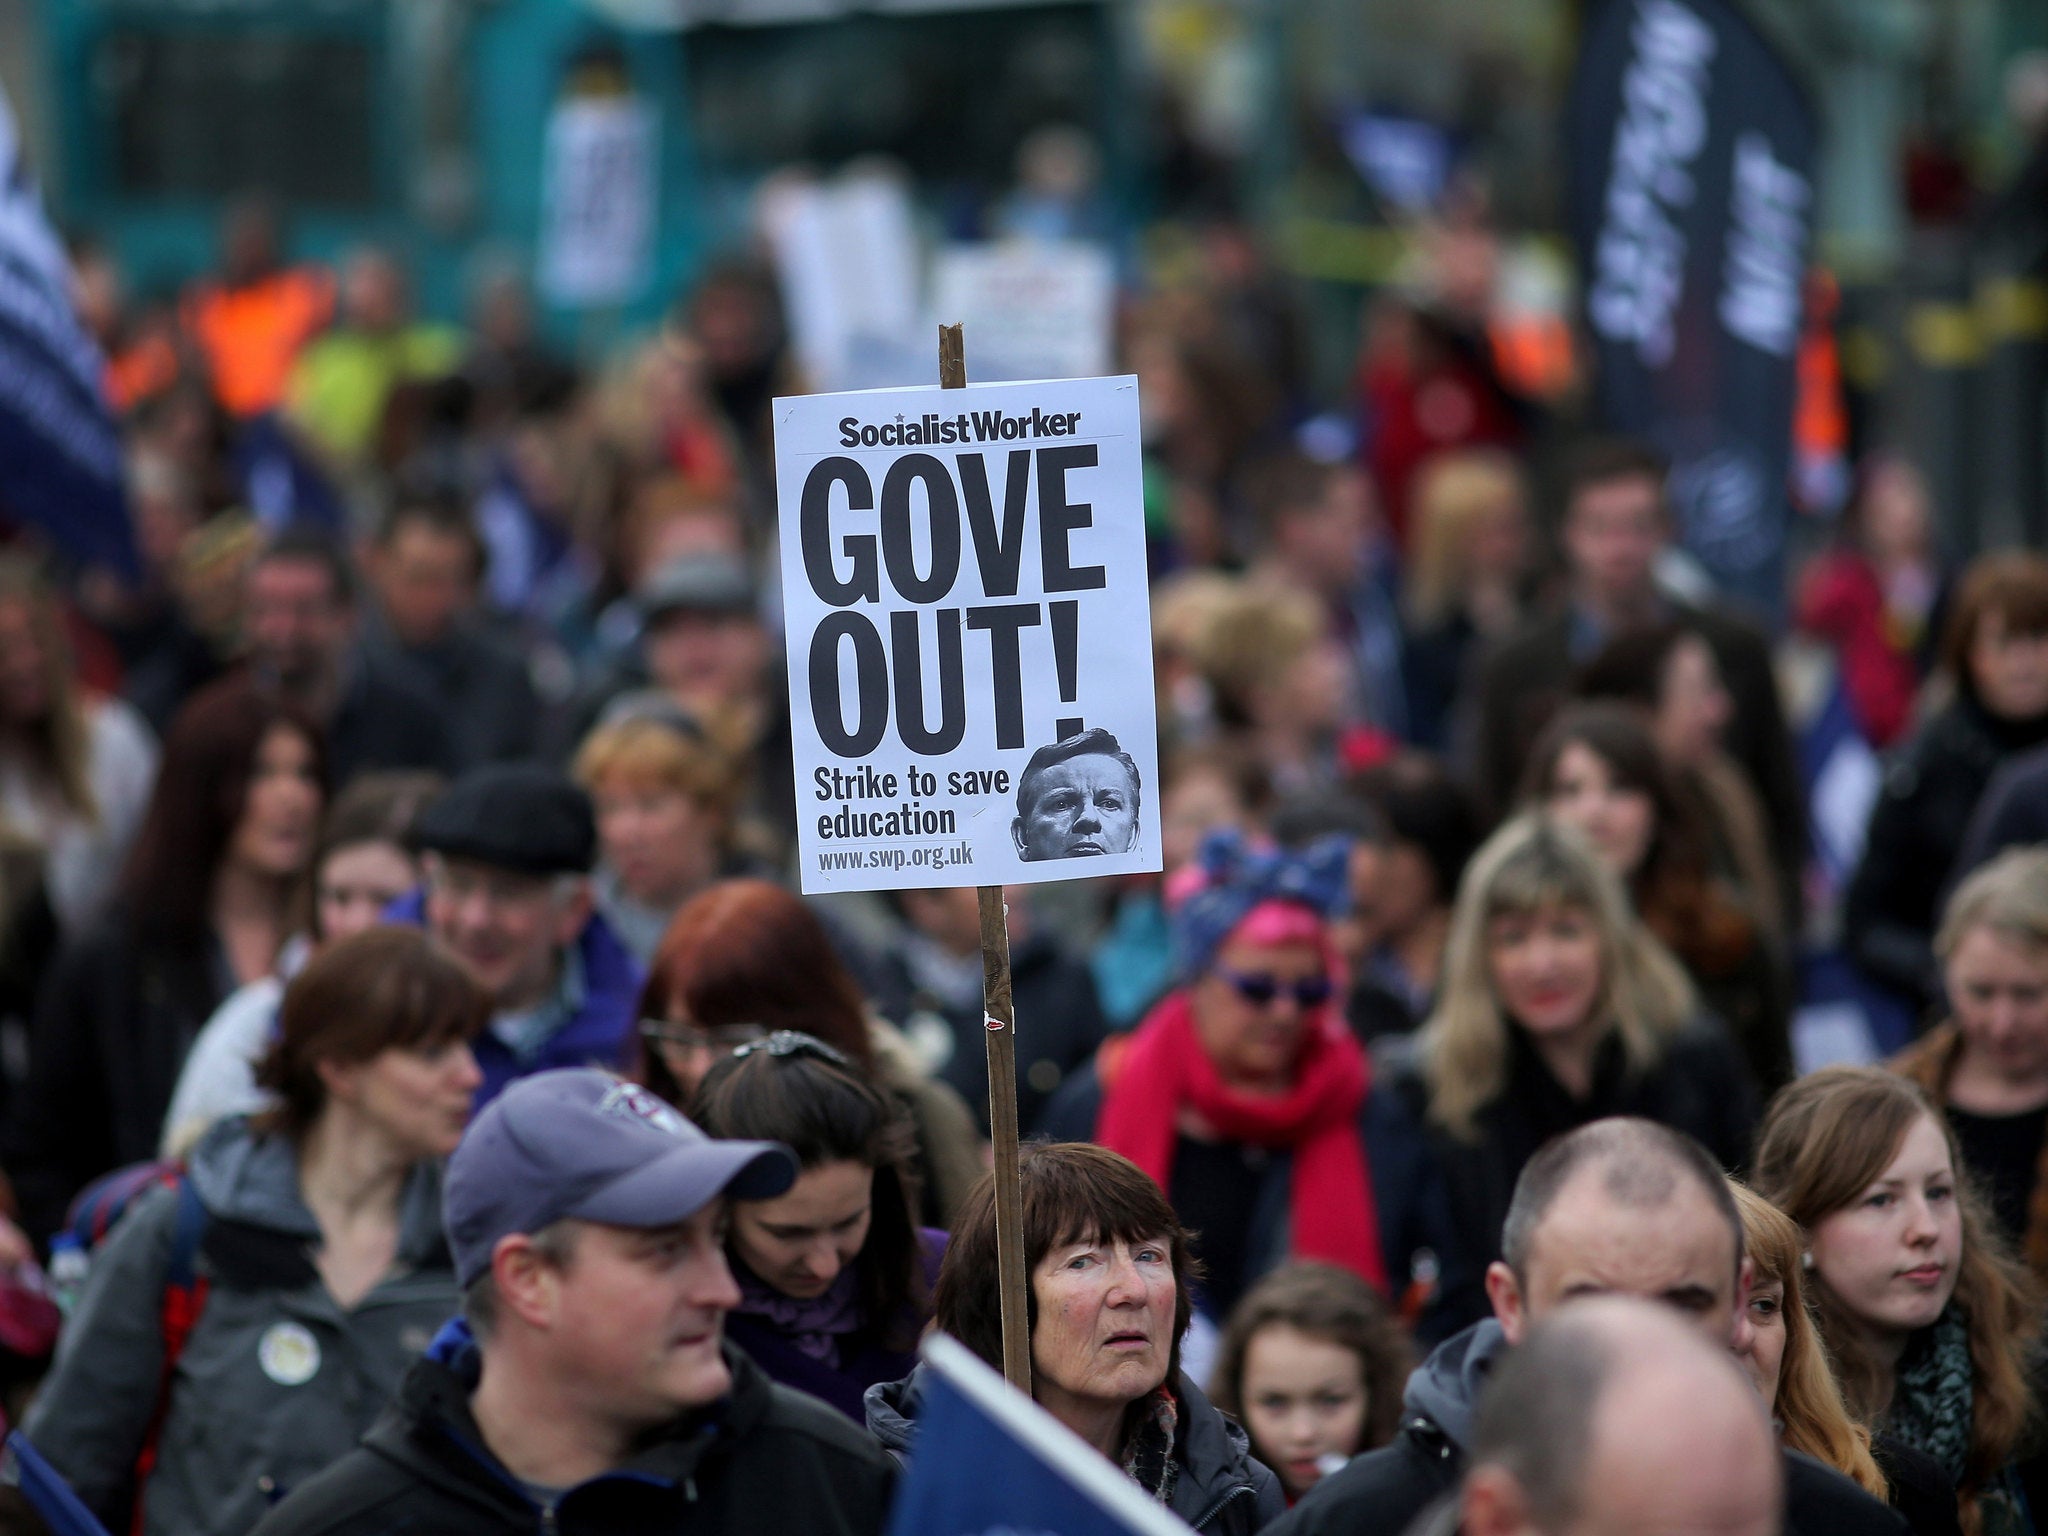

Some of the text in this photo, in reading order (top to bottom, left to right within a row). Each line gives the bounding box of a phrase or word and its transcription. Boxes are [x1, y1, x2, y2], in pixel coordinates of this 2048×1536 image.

[799, 443, 1107, 608] GOVE
[808, 599, 1085, 759] OUT!
[813, 765, 1010, 801] Strike to save
[817, 801, 956, 840] education
[818, 841, 973, 872] www.swp.org.uk
